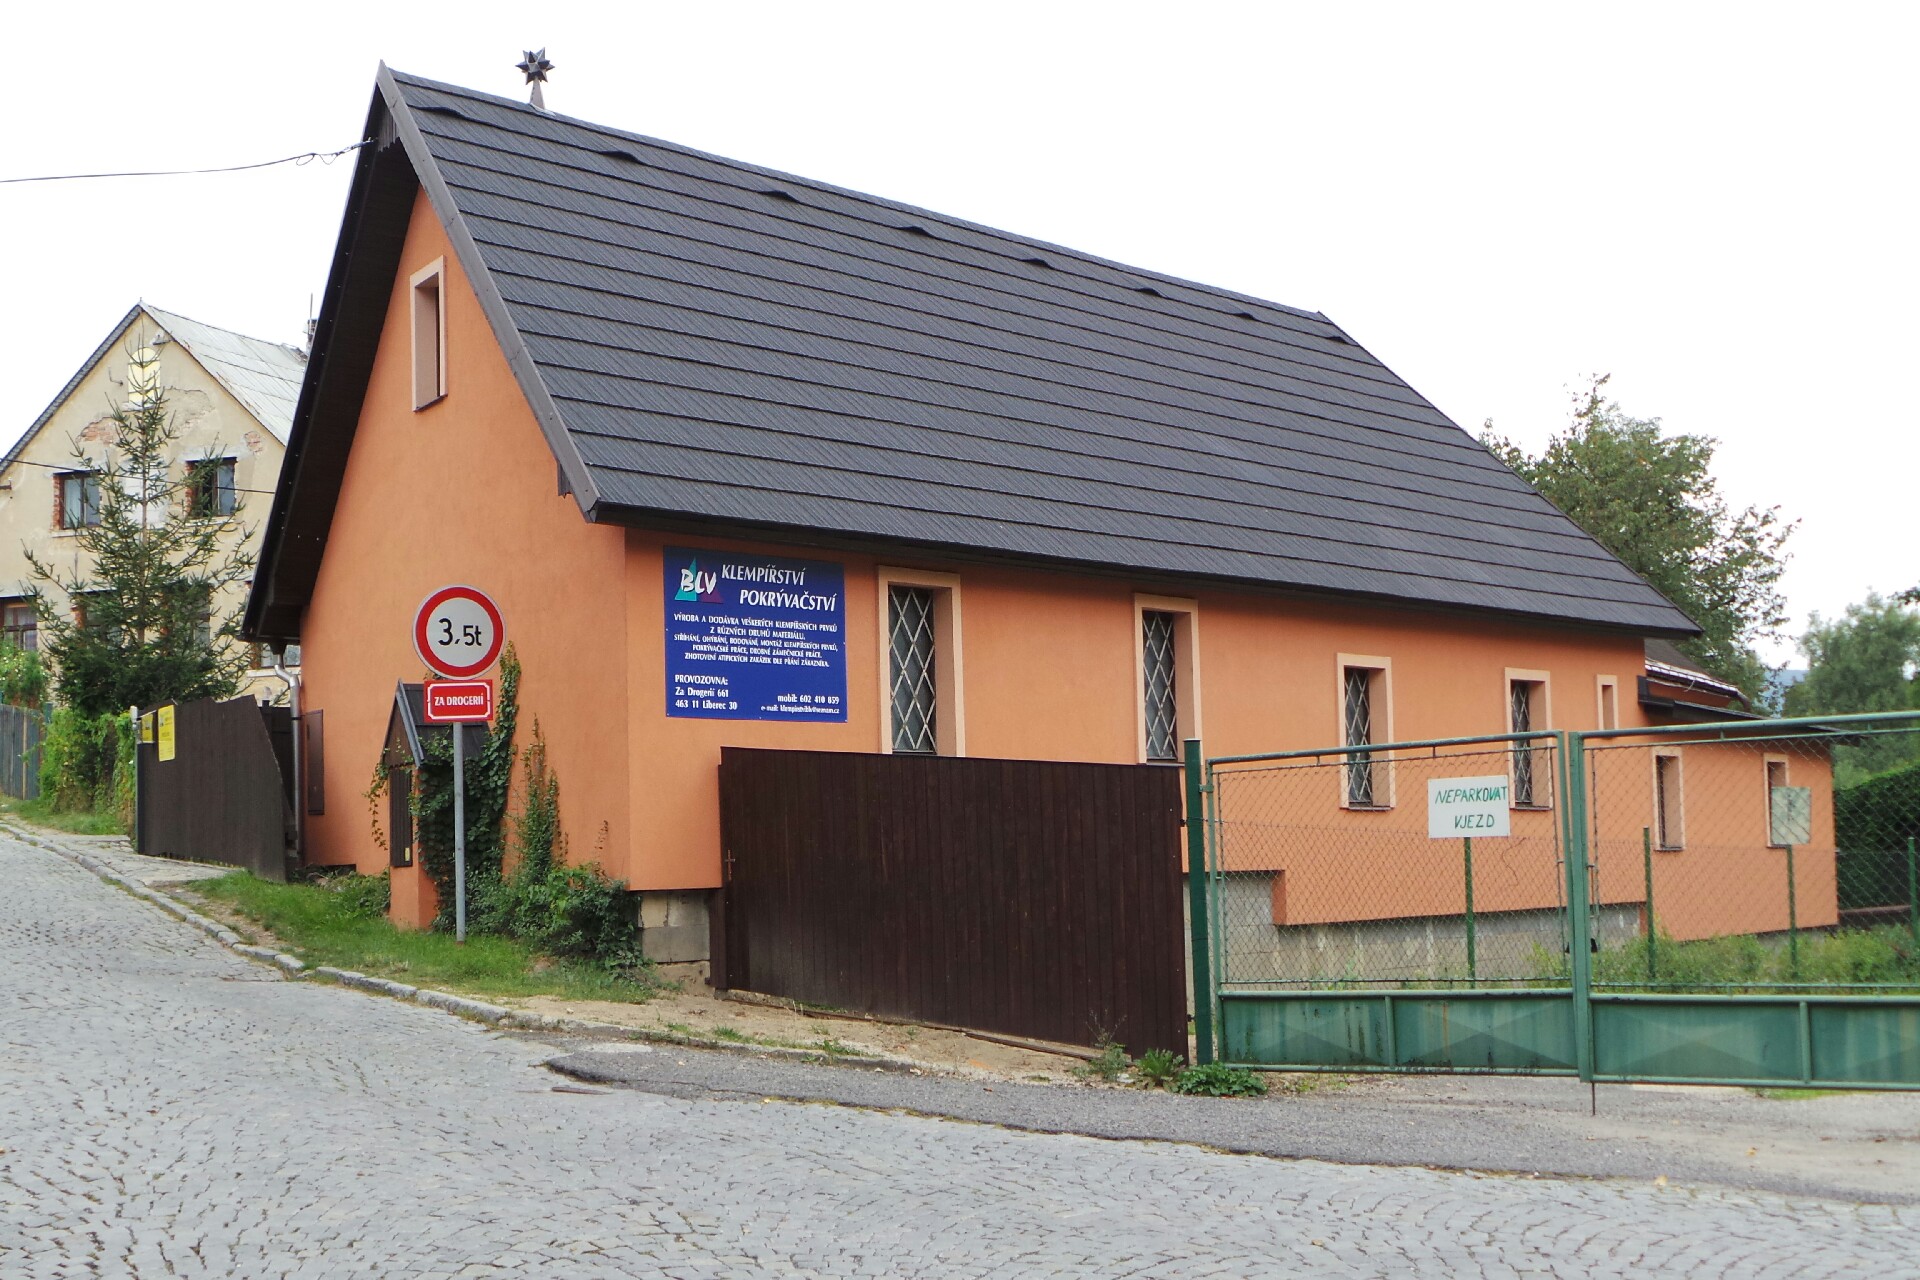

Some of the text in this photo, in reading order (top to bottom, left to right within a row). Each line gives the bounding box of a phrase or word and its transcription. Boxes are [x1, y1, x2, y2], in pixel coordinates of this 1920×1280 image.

[721, 564, 806, 586] KLEMPÍŘSTVÍ
[739, 588, 837, 612] POKRÝVAČSTVÍ
[674, 612, 699, 622] VÝROBA
[708, 614, 739, 625] DODÁVKA
[741, 616, 774, 628] VEŠKERÝCH
[717, 625, 746, 636] RŮZNÝCH
[748, 628, 770, 638] DRUHŮ
[674, 674, 728, 685] PROVOZOVNA:
[434, 692, 484, 706] ZA DROGERIÍ
[675, 686, 684, 696] Za
[717, 689, 728, 698] 661
[777, 693, 798, 702] mobil:
[800, 695, 812, 703] 602
[675, 700, 738, 710] 463 11 Liberec 30
[1435, 786, 1508, 804] NEPARKOVAT
[1454, 814, 1495, 829] VJEZD
